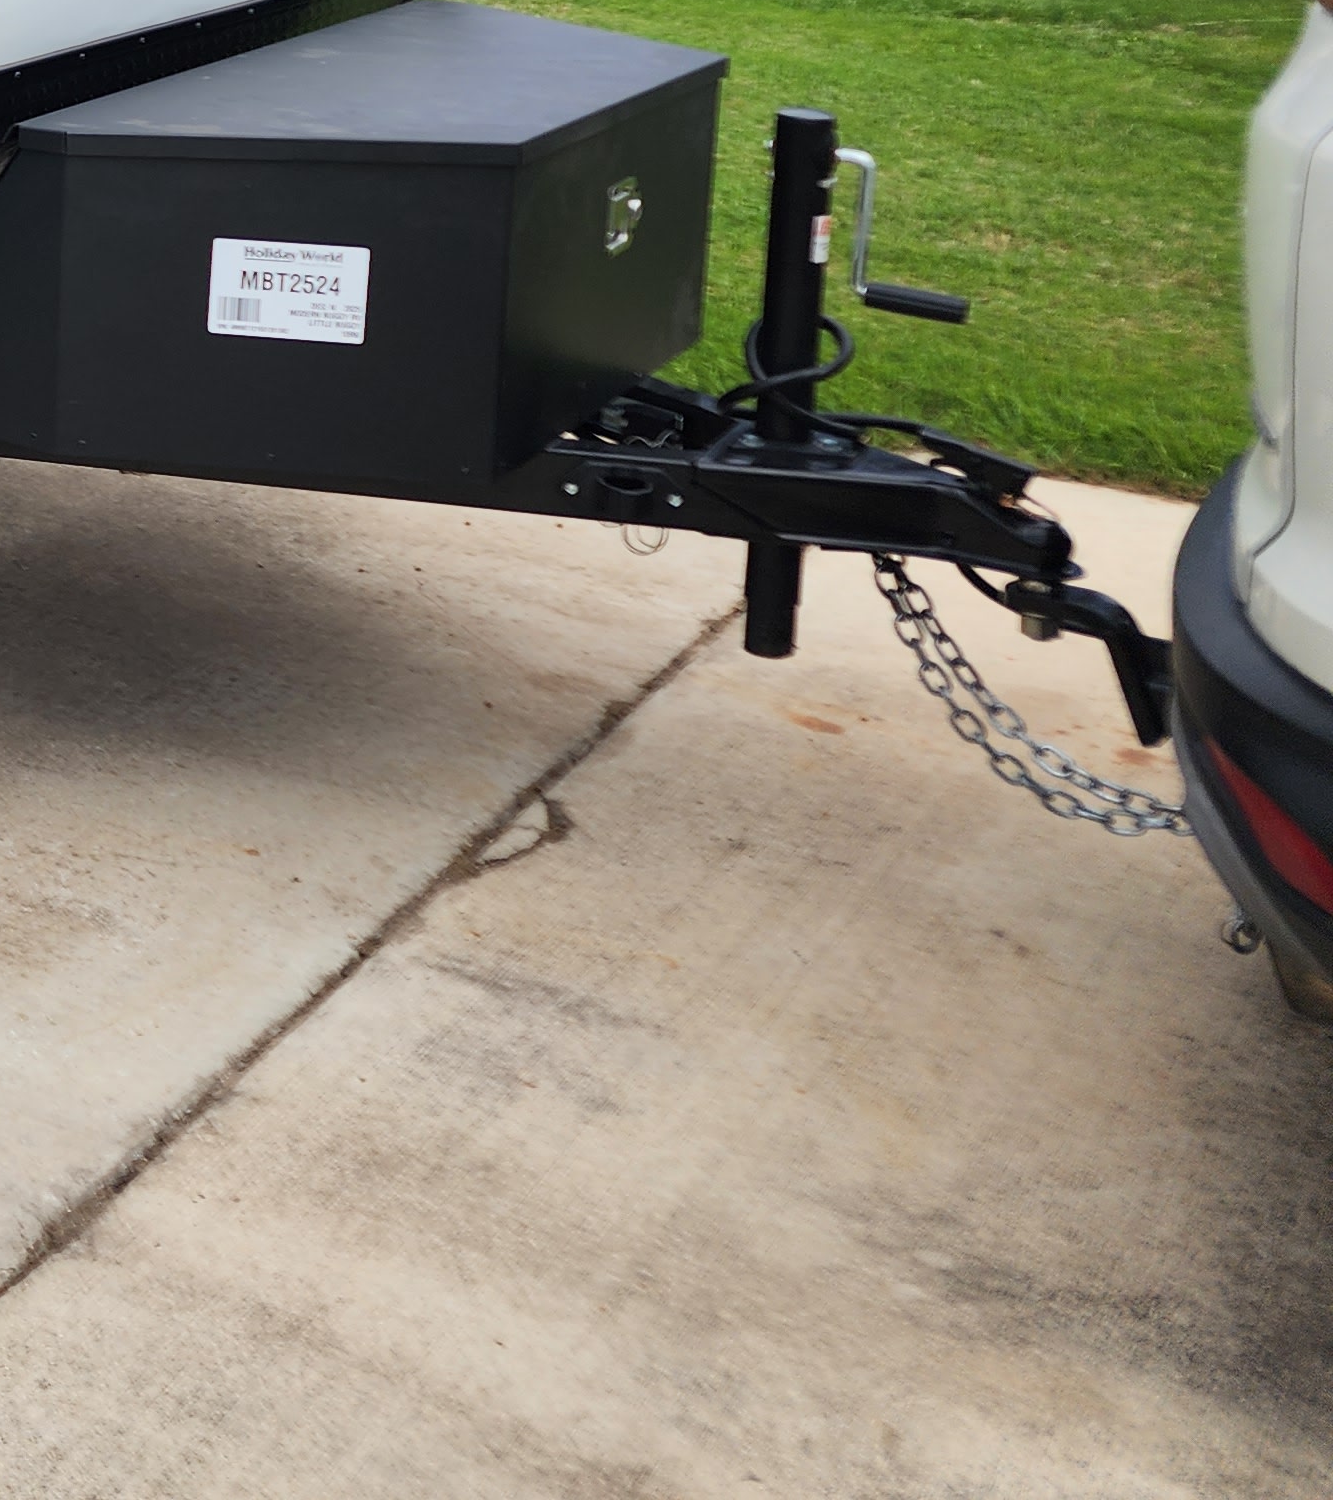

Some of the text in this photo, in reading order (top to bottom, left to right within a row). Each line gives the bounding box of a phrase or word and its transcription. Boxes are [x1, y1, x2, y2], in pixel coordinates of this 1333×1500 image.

[244, 245, 344, 263] Holiday World
[240, 270, 341, 296] MBT2524
